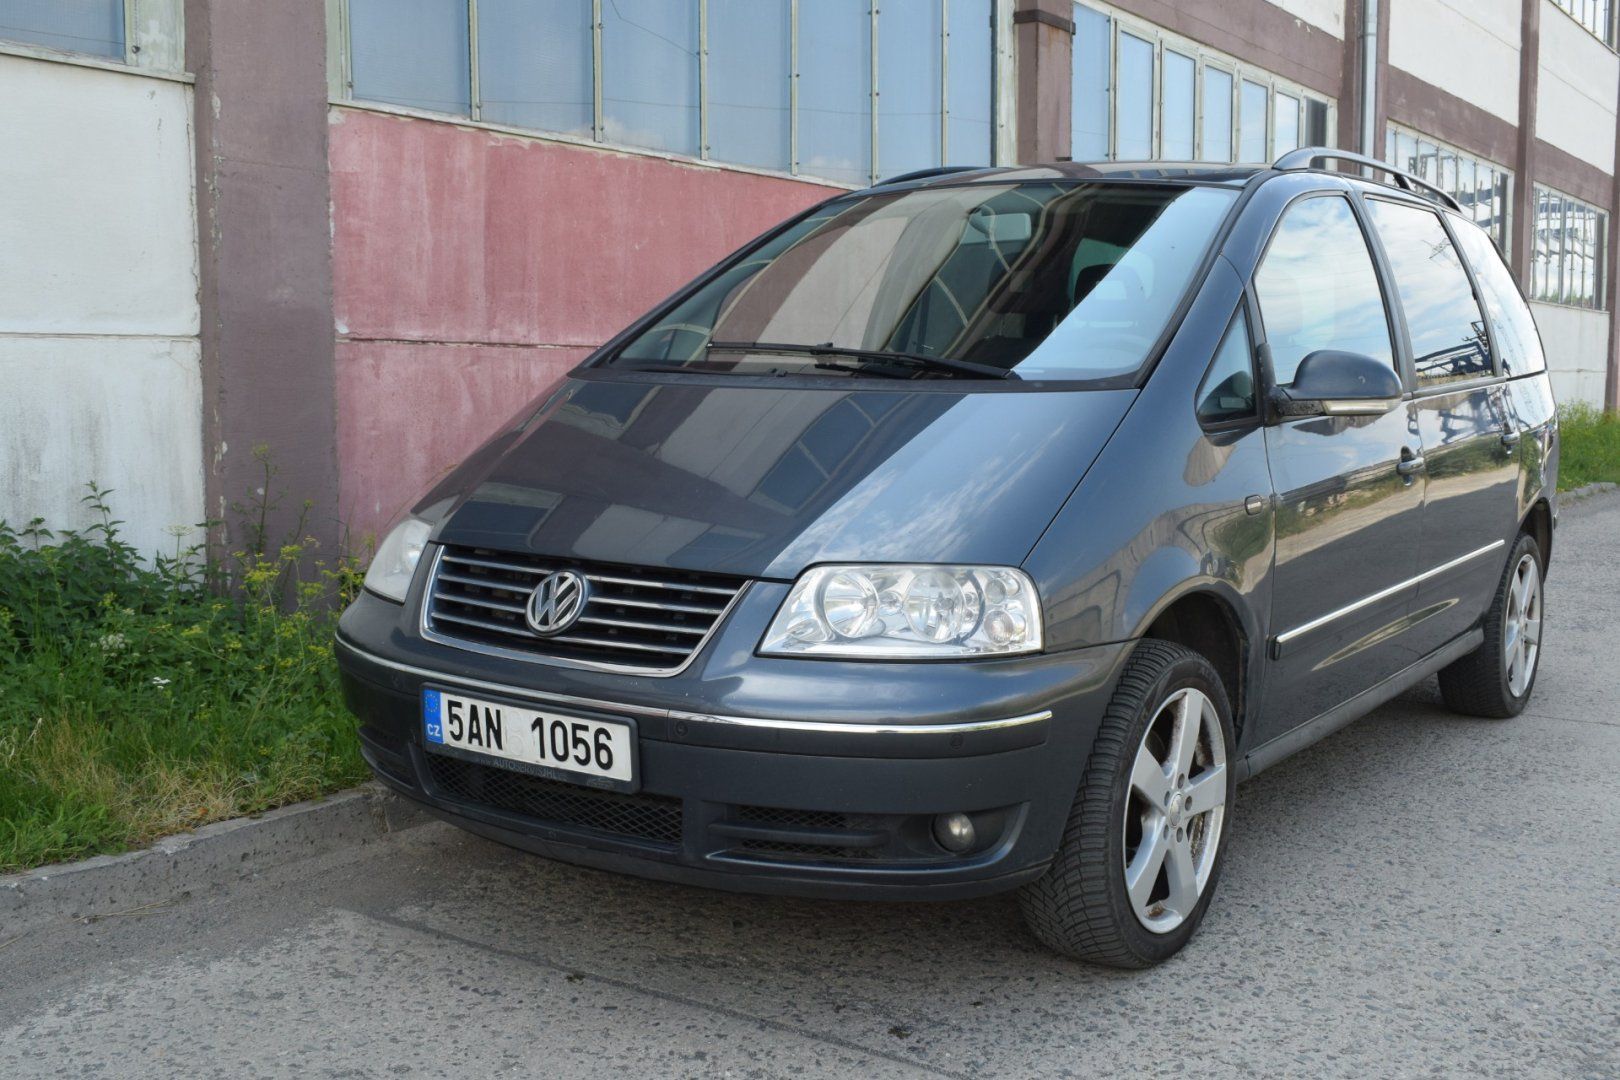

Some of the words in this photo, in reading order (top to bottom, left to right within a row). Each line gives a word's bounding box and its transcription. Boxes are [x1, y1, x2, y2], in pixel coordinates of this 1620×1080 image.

[526, 571, 585, 635] VW
[427, 723, 441, 737] CZ
[447, 699, 503, 750] 5AN
[531, 717, 613, 770] 1056
